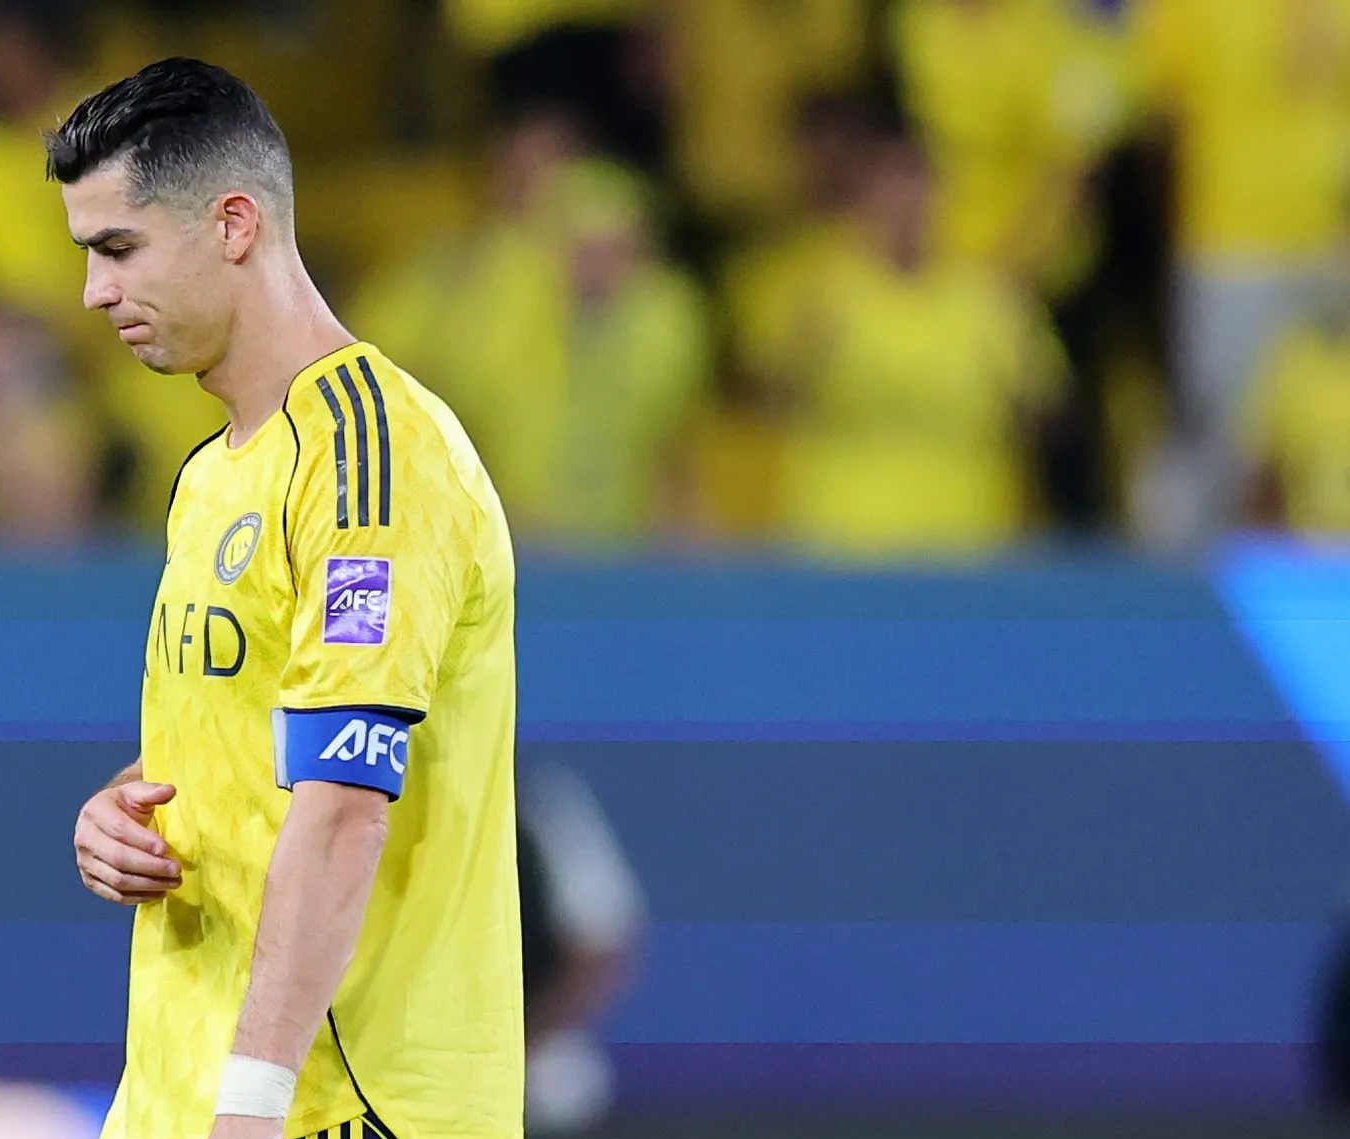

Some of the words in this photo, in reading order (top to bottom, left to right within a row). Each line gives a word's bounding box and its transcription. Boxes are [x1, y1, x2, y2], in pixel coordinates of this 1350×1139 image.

[329, 588, 384, 611] AFC
[144, 602, 247, 678] AFD
[318, 718, 409, 776] AFC
